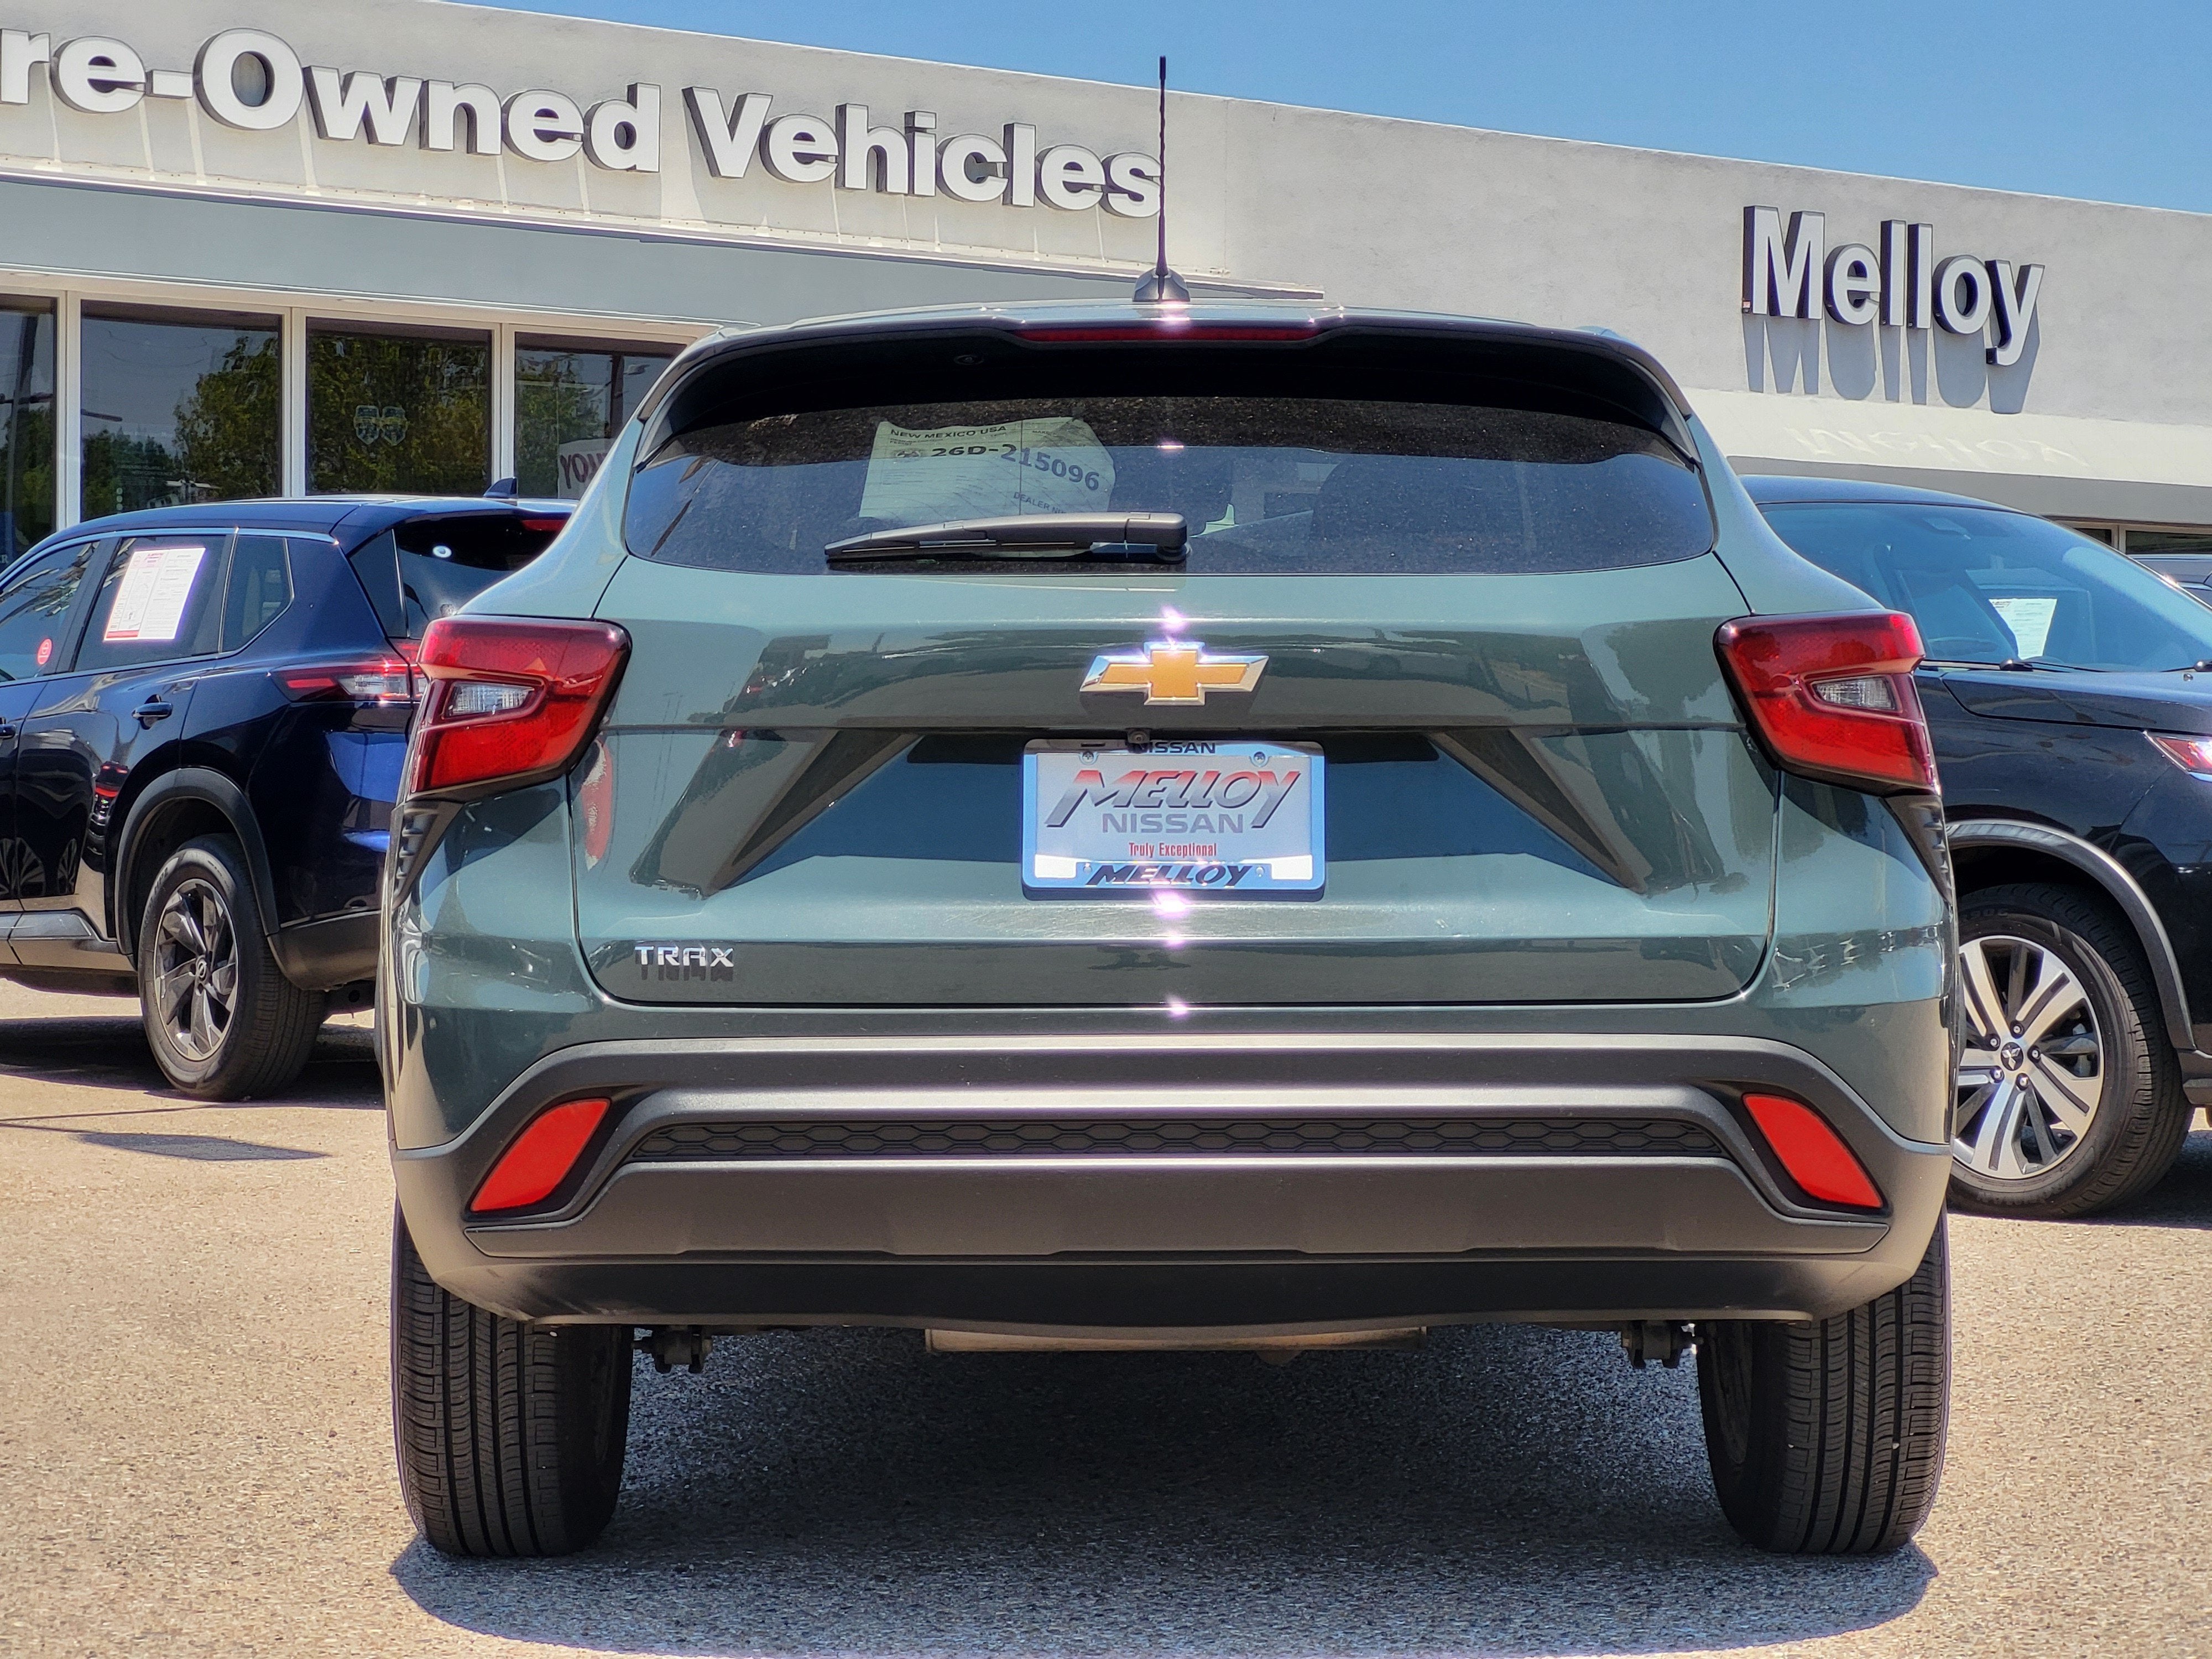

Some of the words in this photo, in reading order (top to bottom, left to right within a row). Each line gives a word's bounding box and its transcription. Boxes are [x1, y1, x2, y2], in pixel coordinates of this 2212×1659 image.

[682, 87, 1161, 218] Vehicles
[1743, 205, 2045, 366] Melloy
[890, 429, 921, 439] NEW
[925, 430, 975, 439] MEXICO
[980, 426, 1006, 435] USA
[1014, 492, 1050, 510] DEALER
[1136, 742, 1215, 754] NISSAN
[1044, 769, 1301, 828] MELLOY
[1102, 813, 1243, 833] NISSAN
[1129, 842, 1155, 858] Truly
[1159, 842, 1217, 858] Exceptional
[1085, 865, 1252, 888] MELLOY
[634, 946, 735, 967] TRAX
